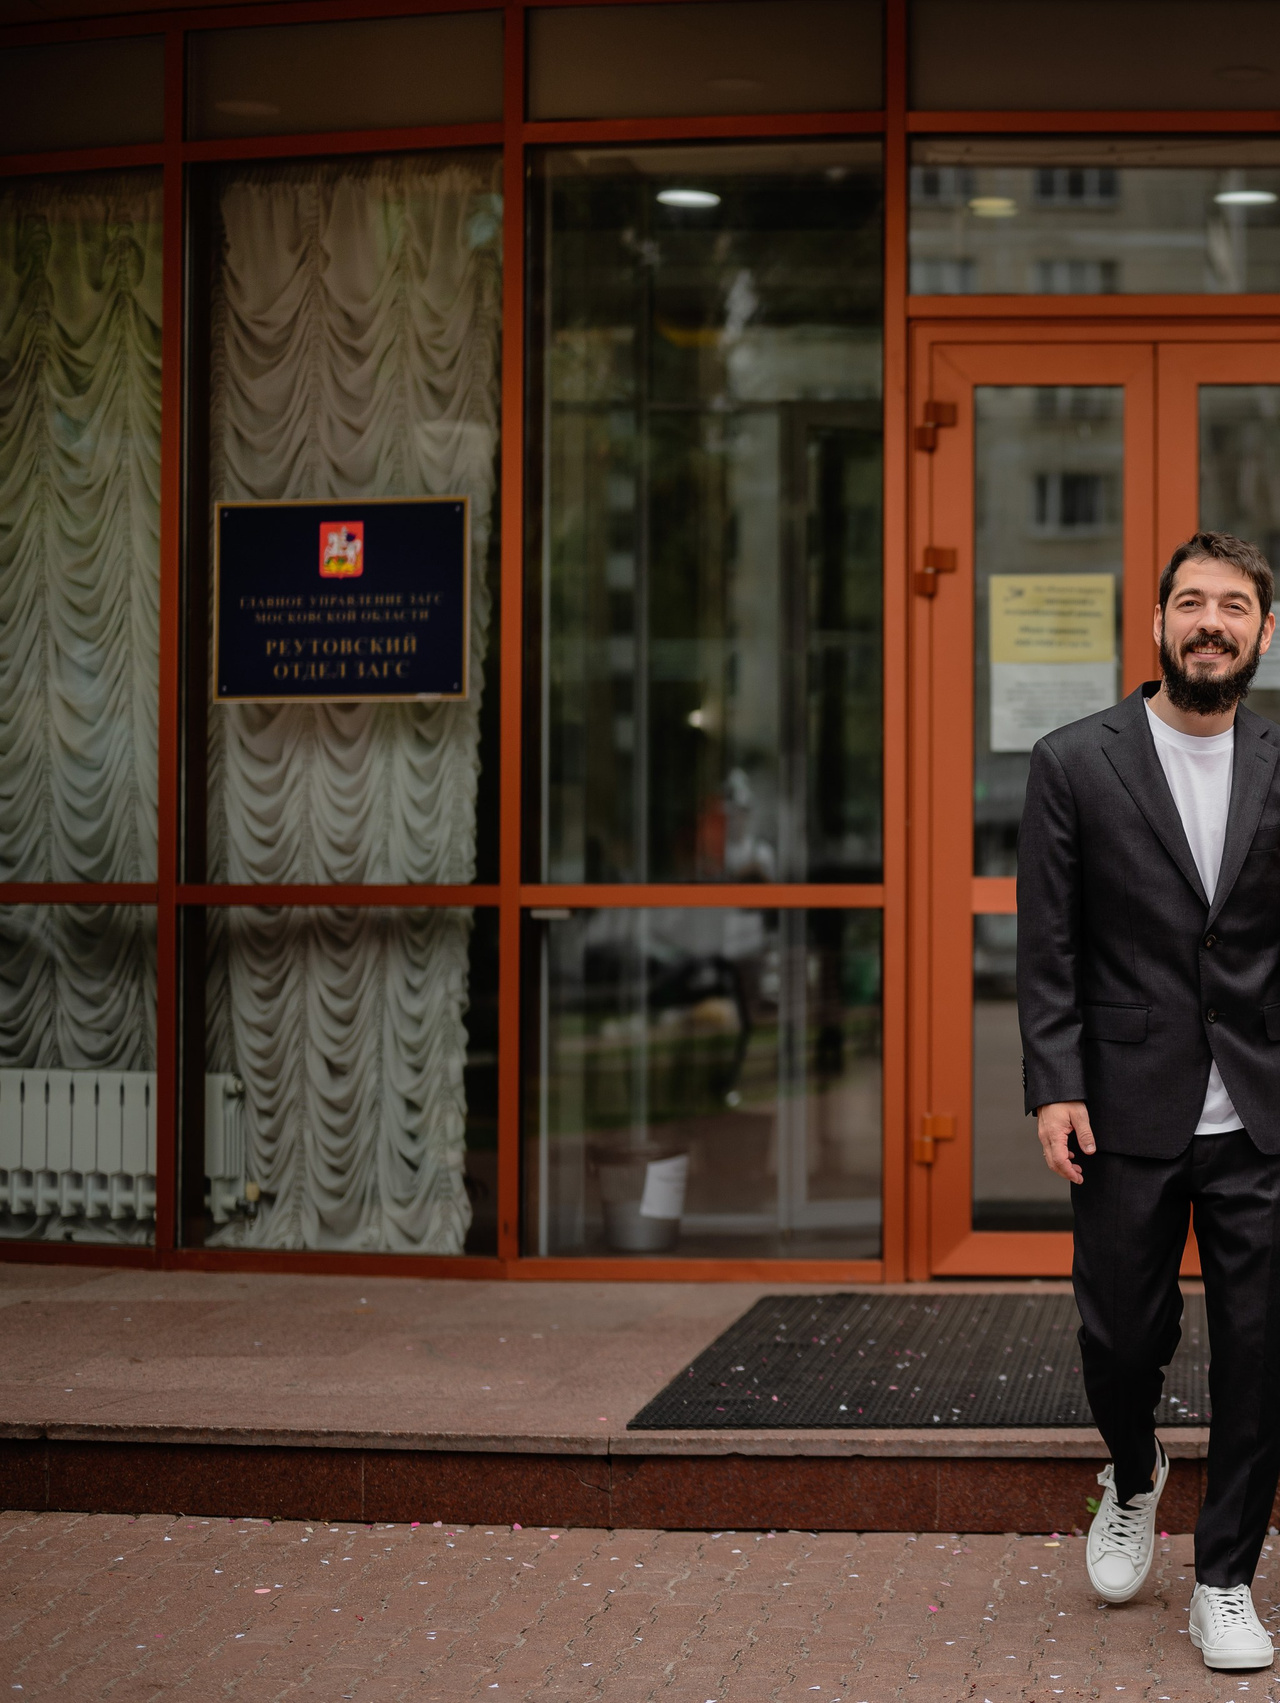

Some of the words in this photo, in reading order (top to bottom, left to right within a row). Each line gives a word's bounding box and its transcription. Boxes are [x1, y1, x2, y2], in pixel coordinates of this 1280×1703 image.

[240, 595, 303, 609] ГЛАВНОЕ
[310, 593, 402, 607] УПРАВЛЕНИЕ
[410, 591, 443, 605] ЗАГС
[255, 609, 357, 624] МОСКОВСКОЙ
[361, 609, 430, 623] ОБЛАСТИ
[266, 632, 417, 656] РЕУТОВСКИЙ
[273, 662, 346, 681] ОТДЕЛ
[357, 660, 411, 679] ЗАГС
